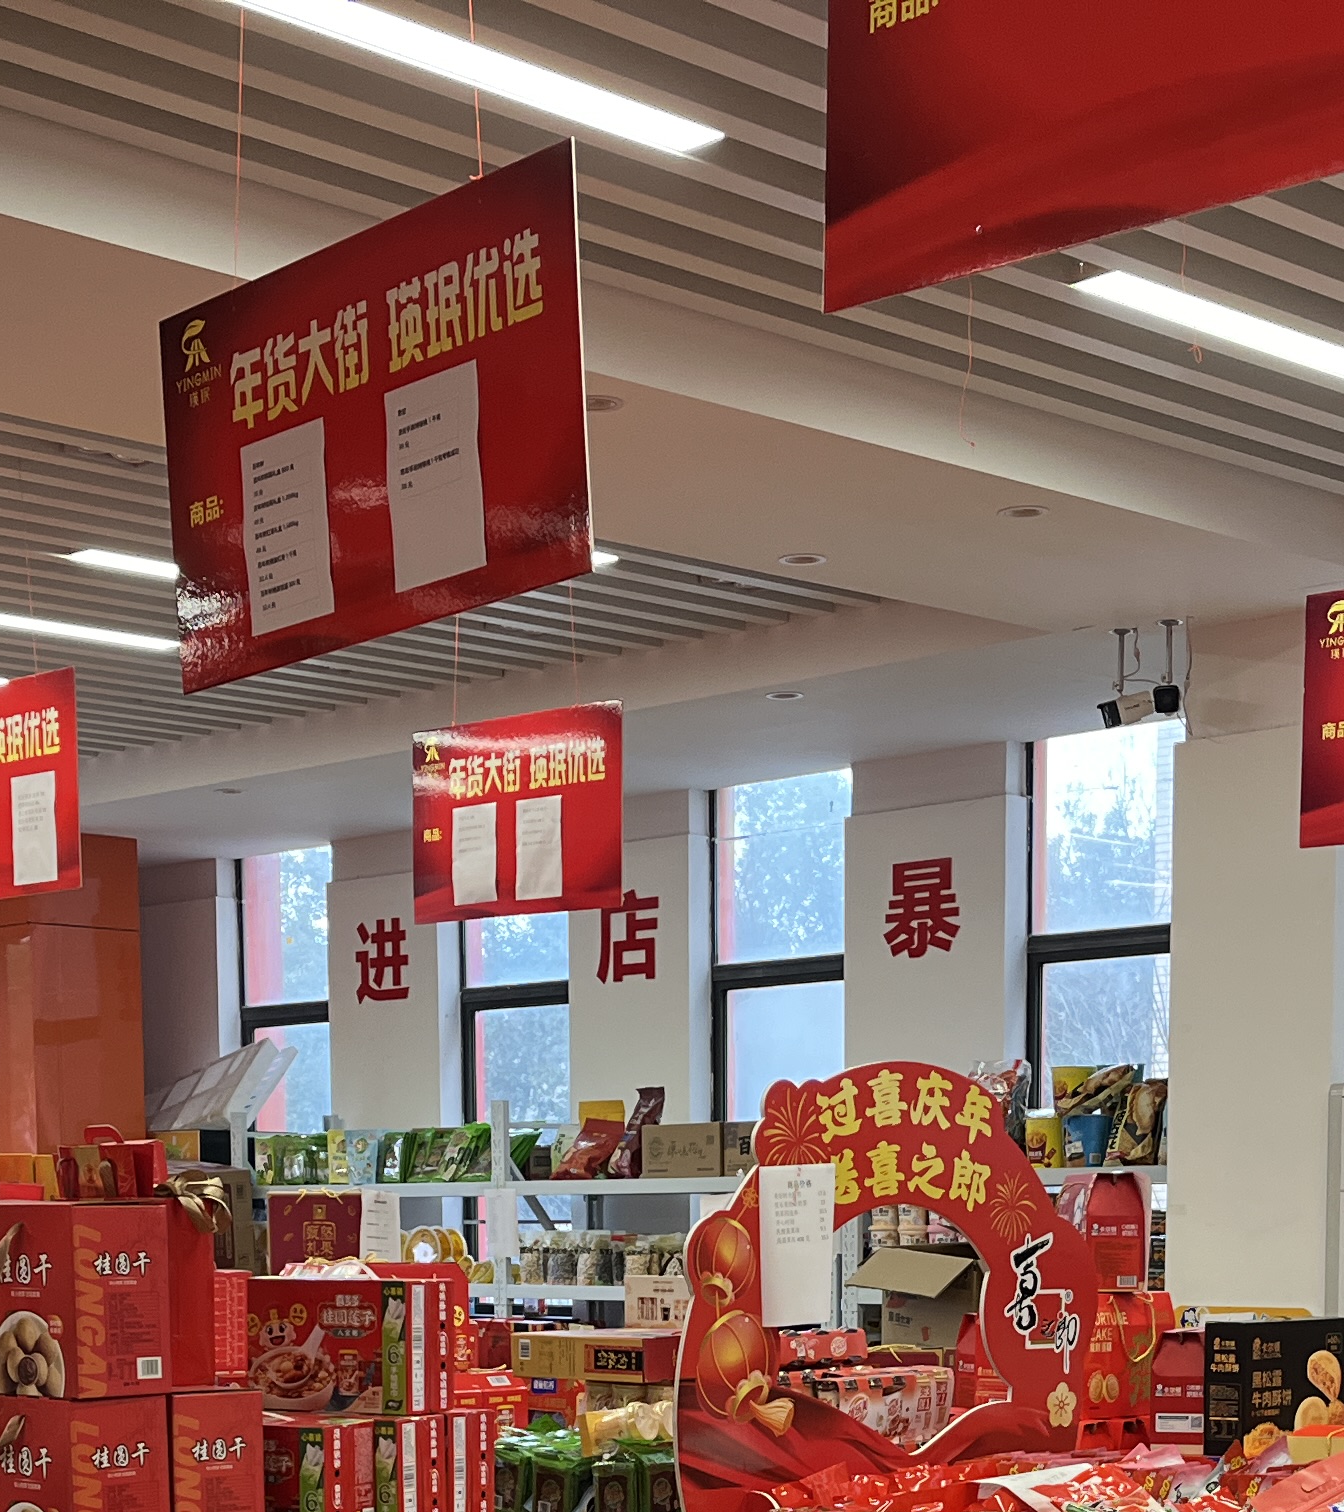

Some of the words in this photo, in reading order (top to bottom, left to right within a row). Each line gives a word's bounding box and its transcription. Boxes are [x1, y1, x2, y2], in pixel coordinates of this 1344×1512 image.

[230, 300, 369, 430] 年货大街
[386, 227, 543, 373] 瑛珉优选
[175, 362, 222, 392] YINGMIN
[189, 494, 224, 528] 商品:
[448, 750, 521, 800] 年货大街
[528, 736, 605, 790] 瑛珉优选
[356, 918, 410, 1004] 进
[596, 889, 659, 984] 店
[883, 856, 961, 960] 暴
[817, 1068, 993, 1145] 过喜庆年
[0, 1252, 53, 1286] 桂圆干
[93, 1250, 152, 1278] 桂圆干
[1094, 1311, 1129, 1326] ORTUNE
[0, 1441, 53, 1477] 桂圆干
[91, 1441, 151, 1471] 桂圆干
[191, 1434, 247, 1464] 桂圆干
